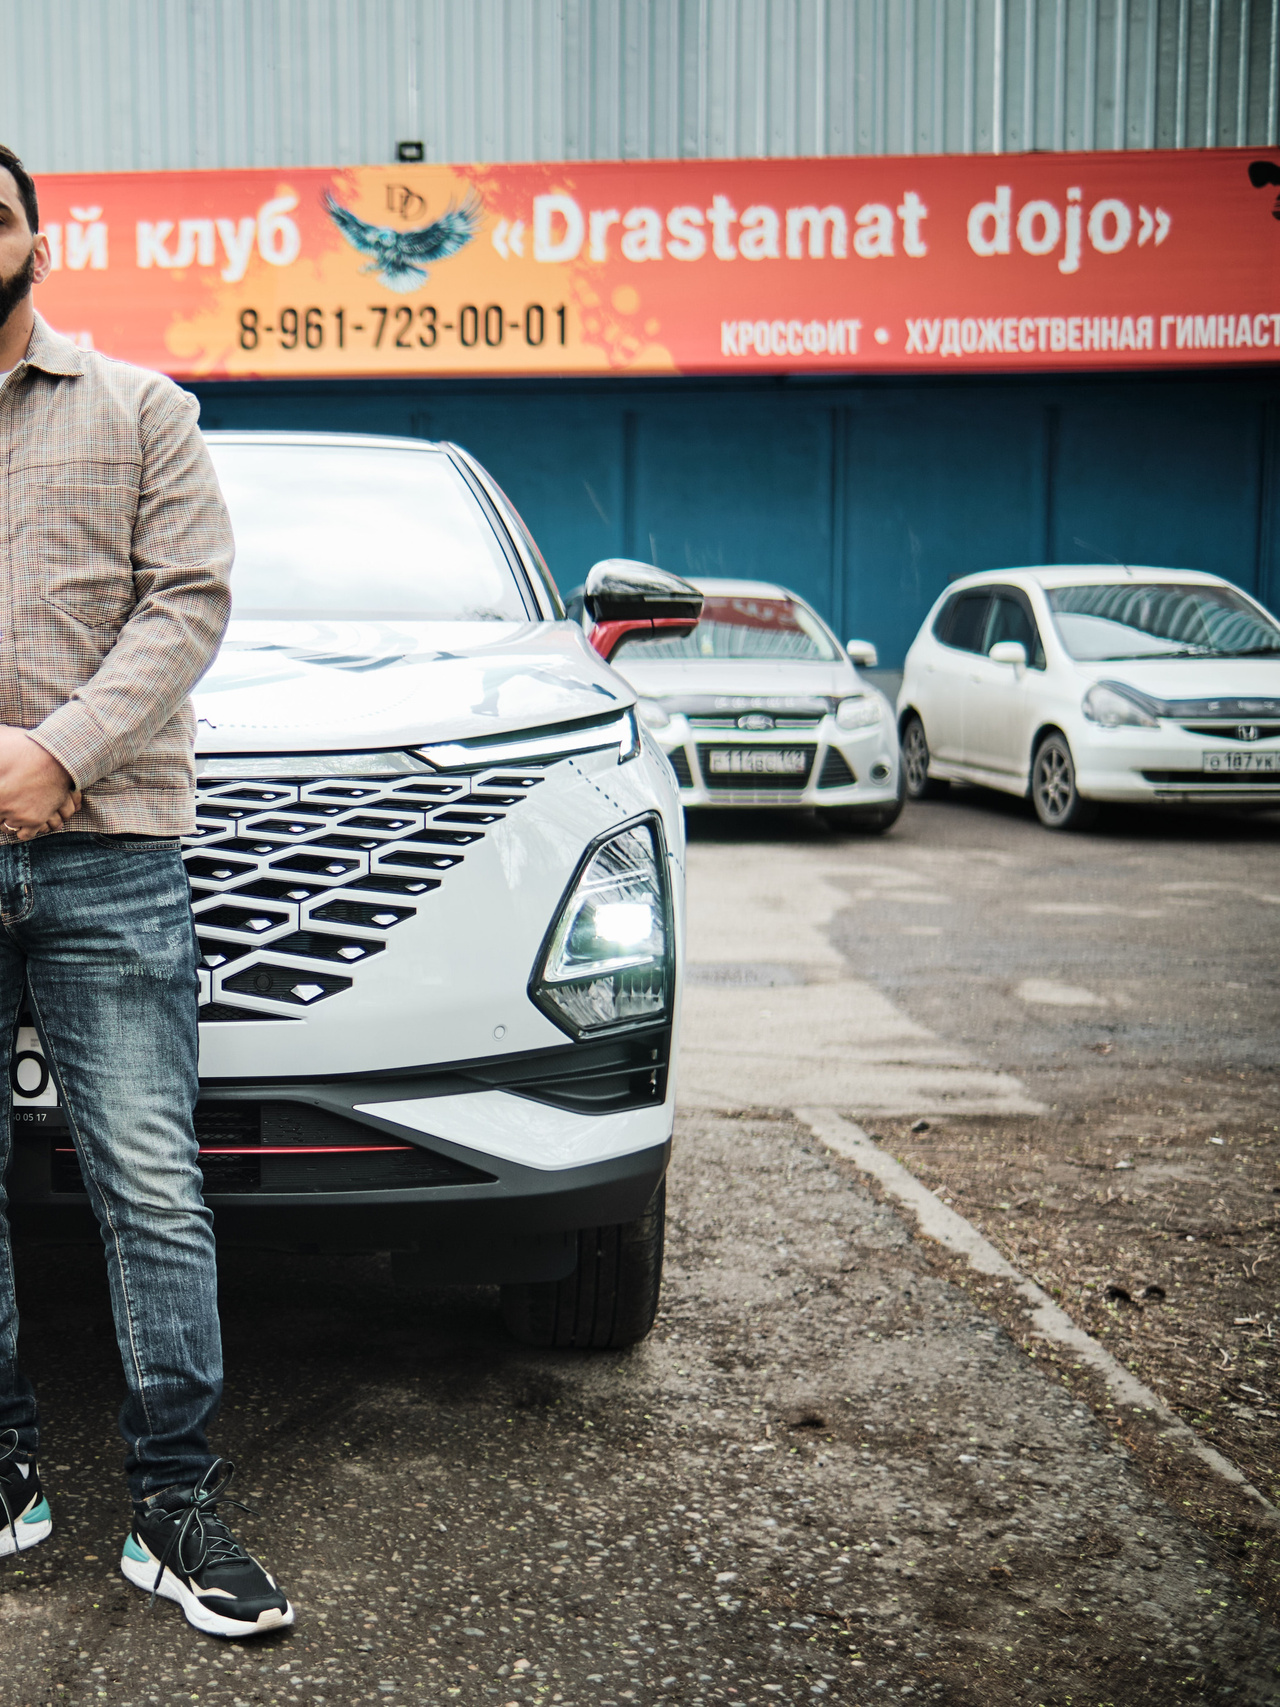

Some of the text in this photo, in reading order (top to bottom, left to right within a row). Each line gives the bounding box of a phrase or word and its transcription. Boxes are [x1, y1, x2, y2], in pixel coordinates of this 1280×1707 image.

[136, 196, 302, 283] клуб
[492, 186, 1171, 274] «Drastamat dojo»
[239, 303, 569, 351] 8-961-723-00-01
[721, 319, 861, 356] КРОССФИТ
[904, 316, 1152, 357] ХУДОЖЕСТВЕННАЯ
[23, 1113, 34, 1121] 05
[36, 1113, 47, 1121] 17
